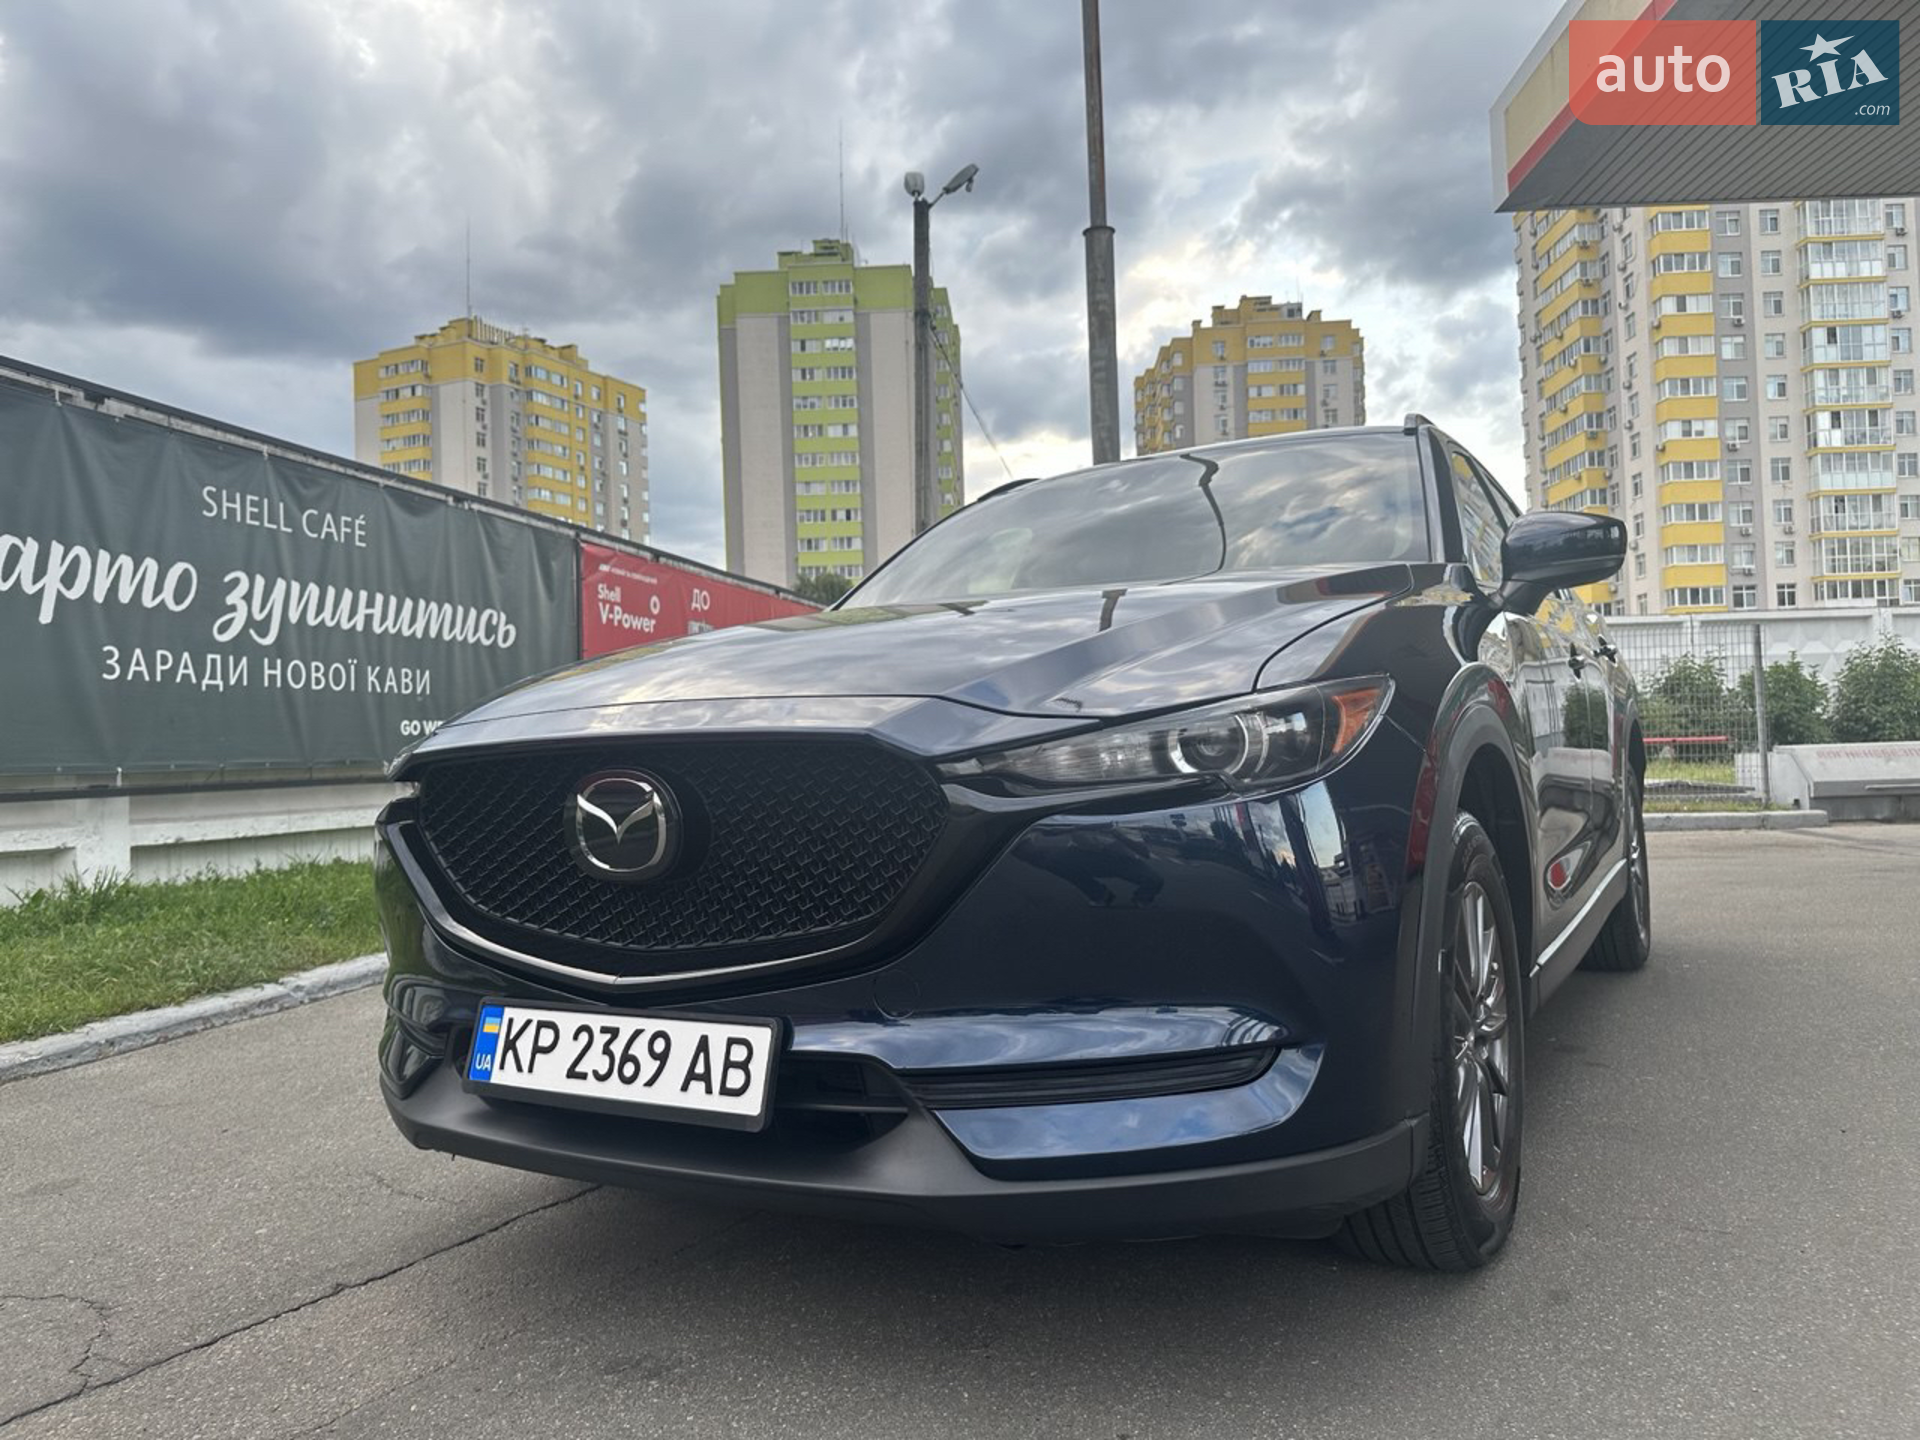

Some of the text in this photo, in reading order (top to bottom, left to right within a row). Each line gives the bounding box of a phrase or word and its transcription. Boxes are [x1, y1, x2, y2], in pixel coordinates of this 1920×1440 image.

[202, 485, 368, 548] SHELL CAFÉ
[212, 570, 517, 649] зупинитись
[597, 582, 621, 603] Shell
[598, 601, 656, 634] V-Power
[102, 645, 431, 695] ЗАРАДИ НОВОЇ КАВИ
[400, 719, 421, 736] GO
[475, 1053, 491, 1071] UA
[499, 1017, 754, 1098] KP 2369 AB
